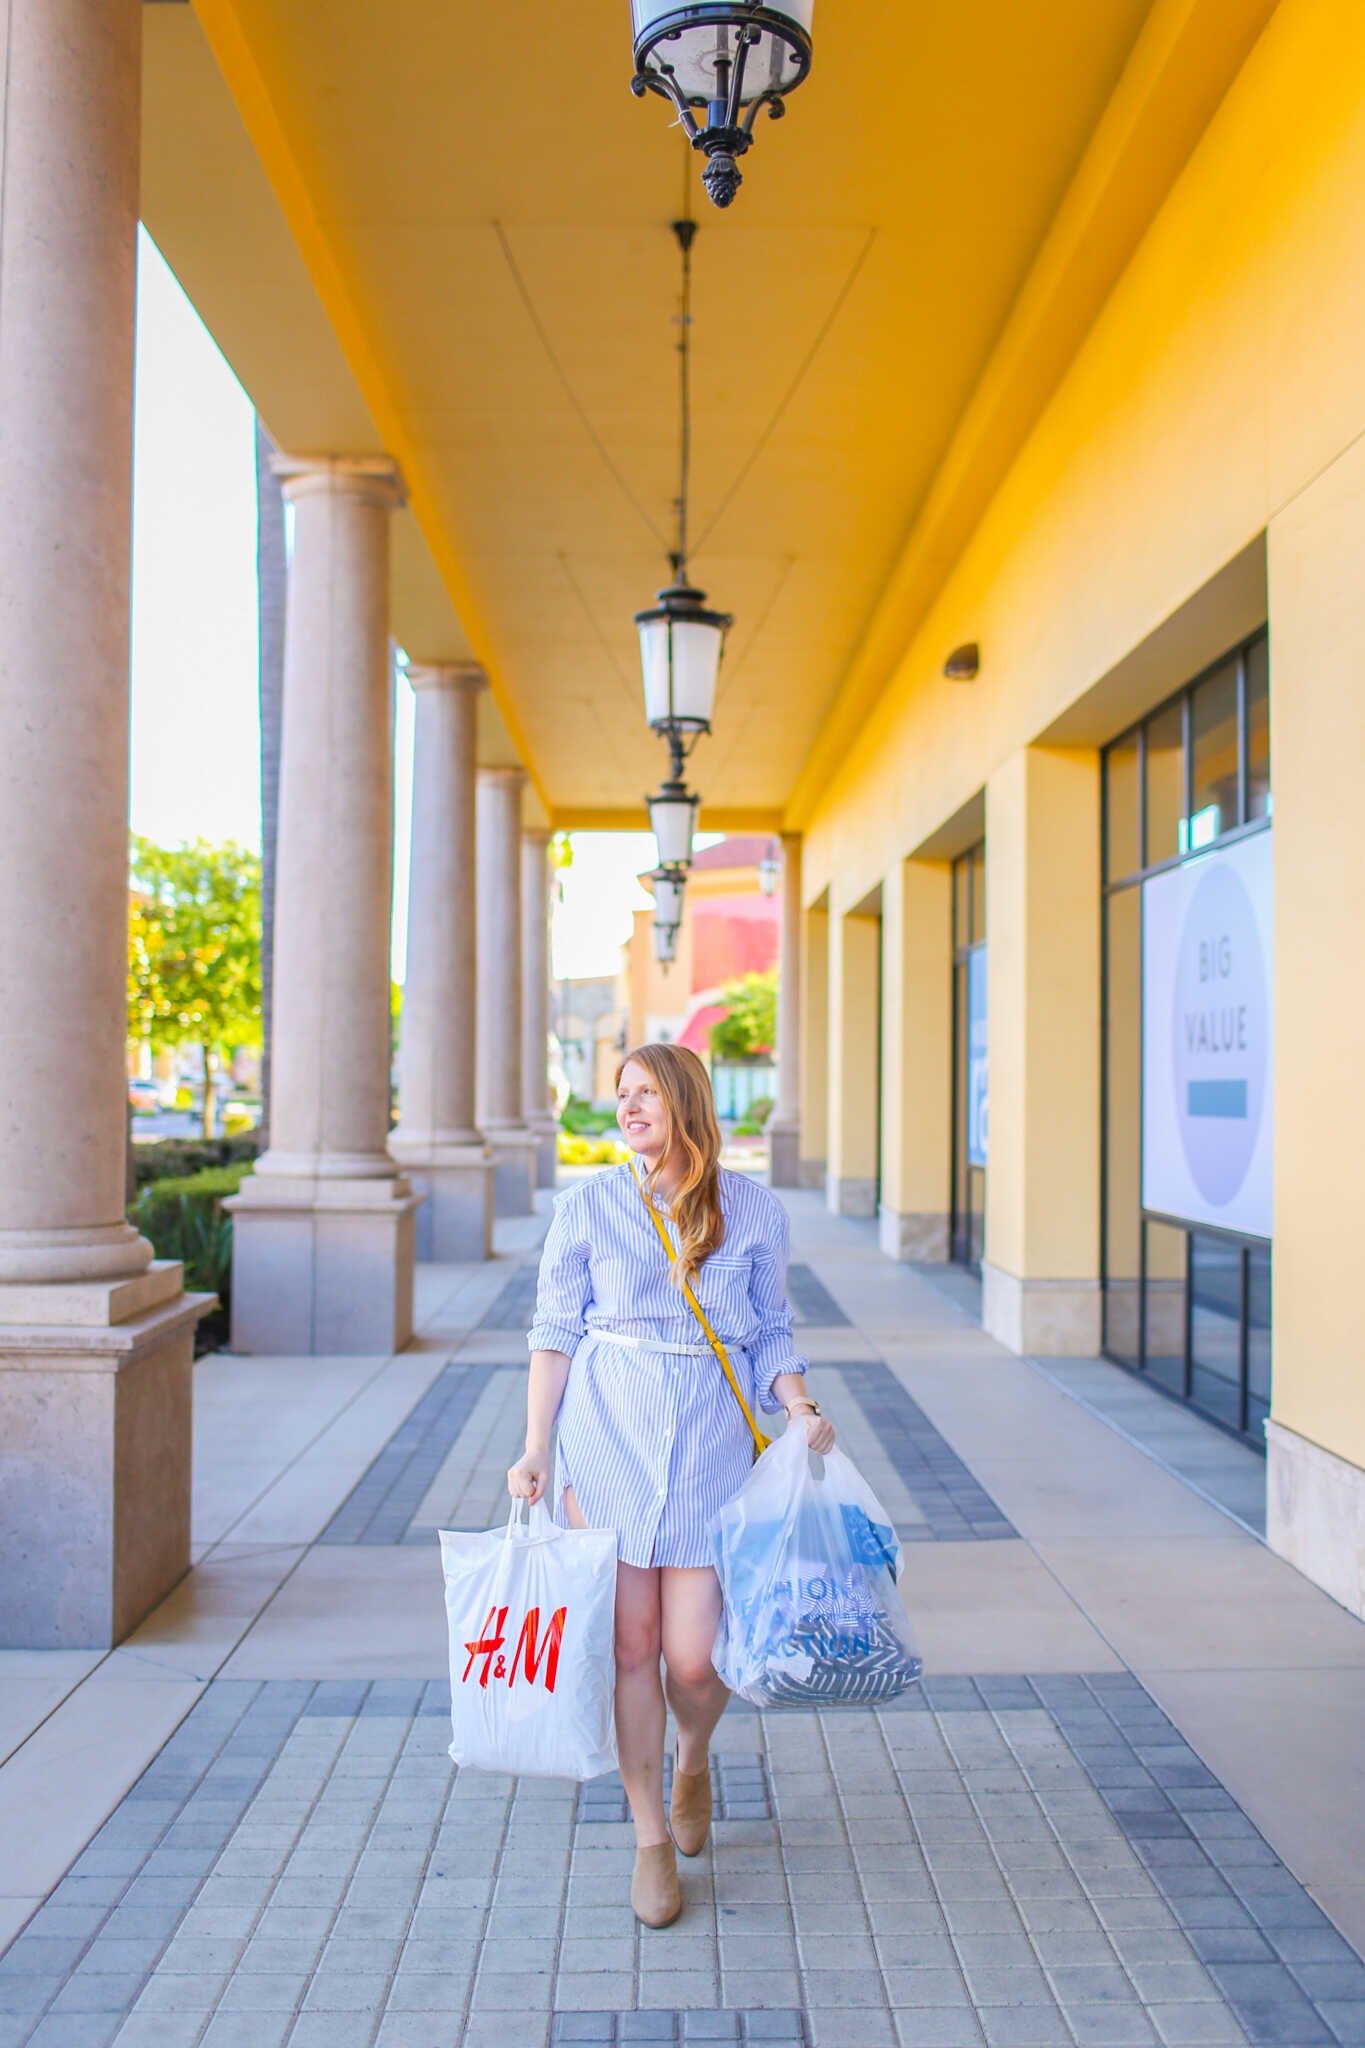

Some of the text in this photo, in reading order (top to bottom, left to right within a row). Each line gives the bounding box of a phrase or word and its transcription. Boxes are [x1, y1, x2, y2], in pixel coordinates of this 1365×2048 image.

[1198, 934, 1231, 984] BIG
[1184, 1004, 1248, 1054] VALUE
[462, 1606, 567, 1693] H&M
